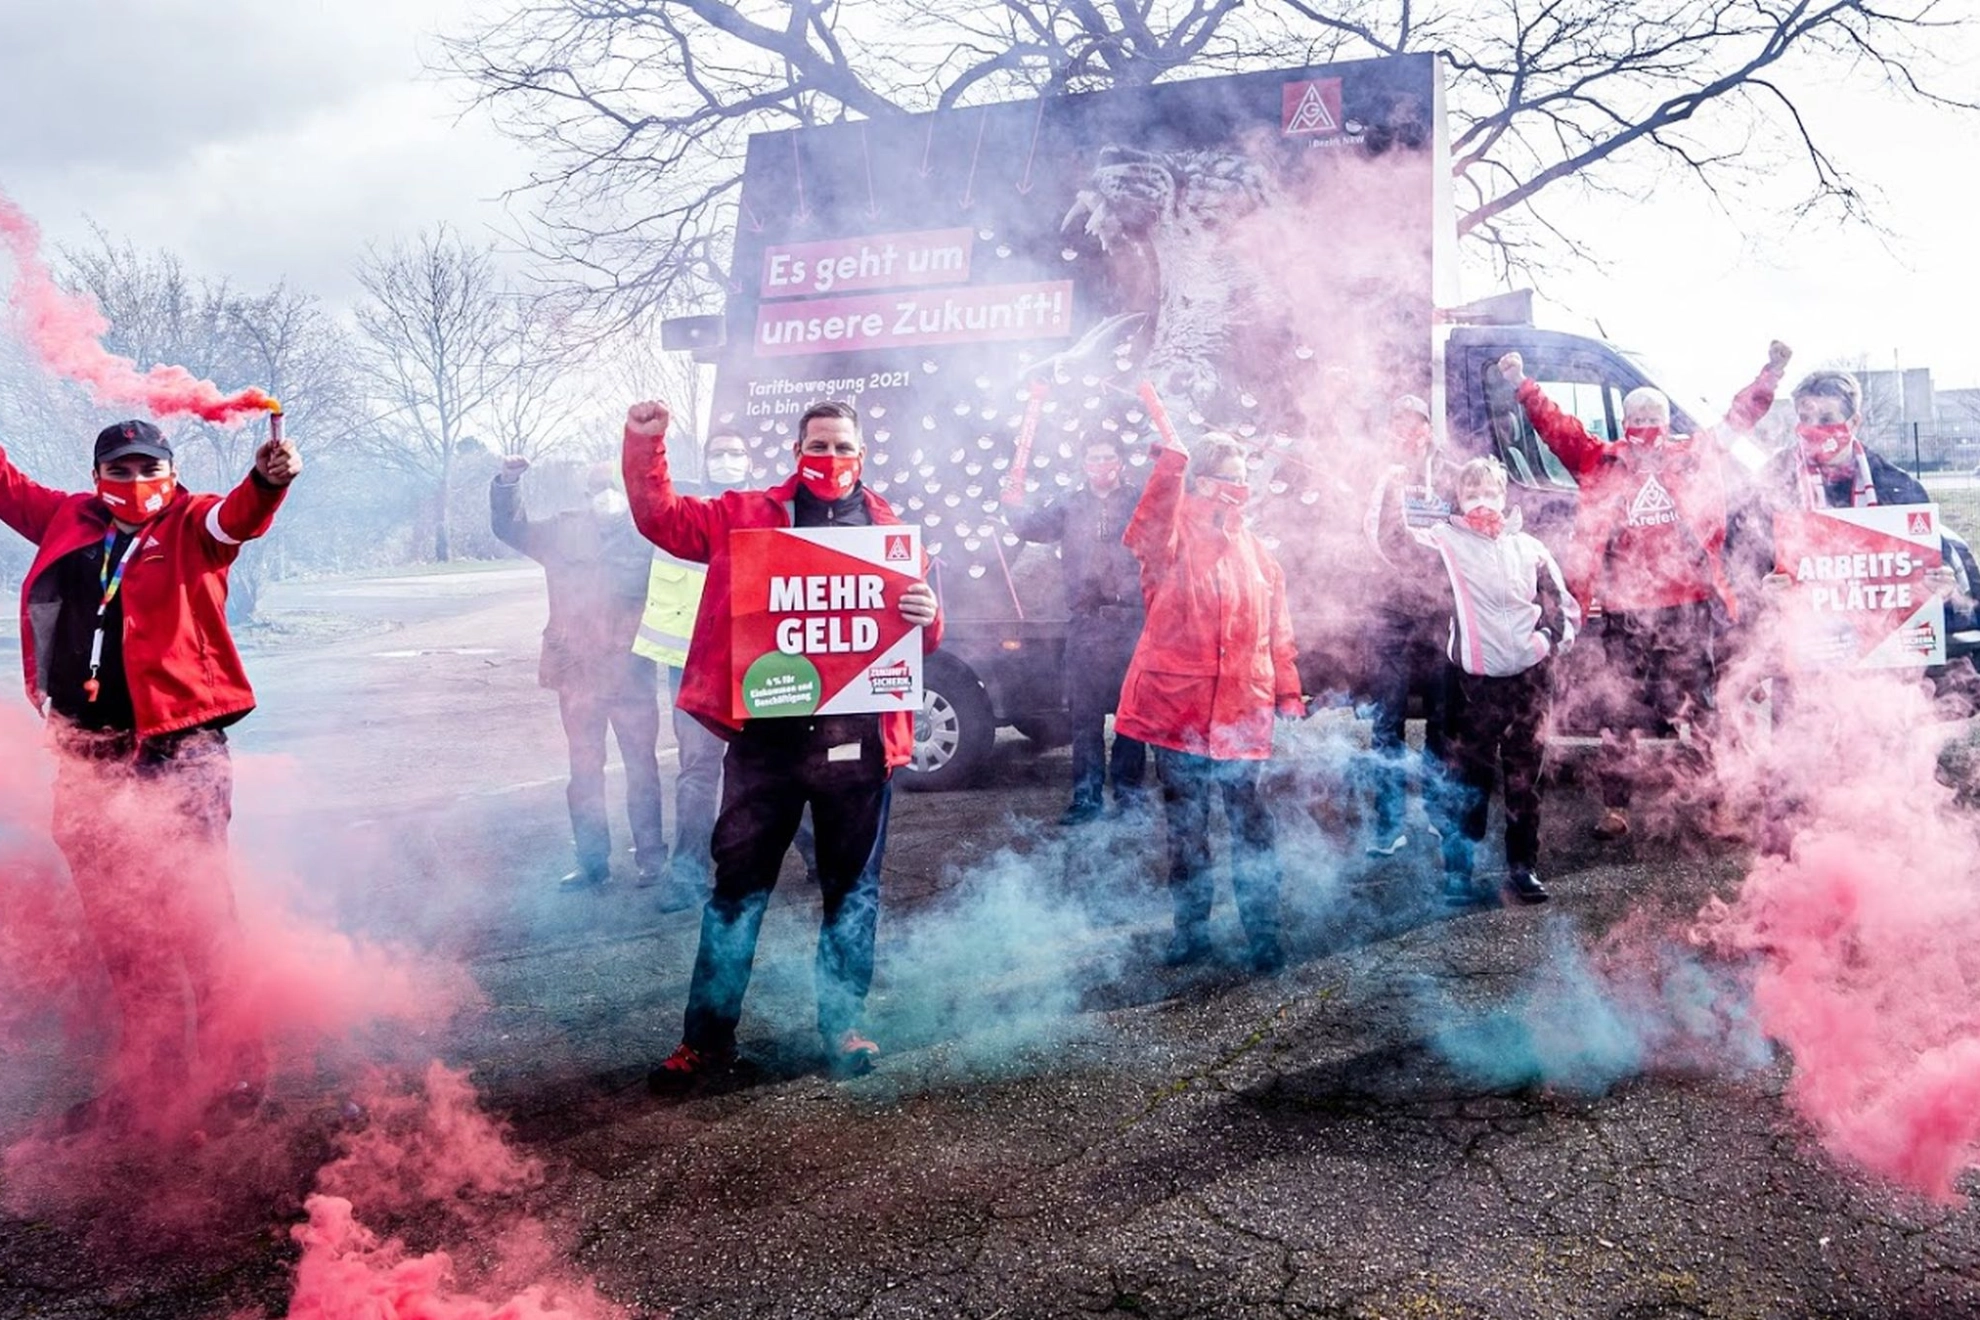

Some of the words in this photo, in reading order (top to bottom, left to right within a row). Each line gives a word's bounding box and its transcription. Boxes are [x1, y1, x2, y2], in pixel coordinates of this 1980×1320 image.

[769, 254, 806, 286] Es
[814, 244, 898, 292] geht
[907, 246, 964, 272] um
[762, 313, 884, 344] unsere
[892, 291, 1062, 335] Zukunft!
[748, 377, 865, 395] Tarifbewegung
[869, 371, 910, 388] 2021
[746, 401, 770, 416] Ich
[774, 399, 799, 414] bin
[1797, 551, 1924, 581] ARBEITS-
[769, 575, 886, 612] MEHR
[1811, 579, 1912, 612] PLÄTZE
[776, 616, 879, 655] GELD
